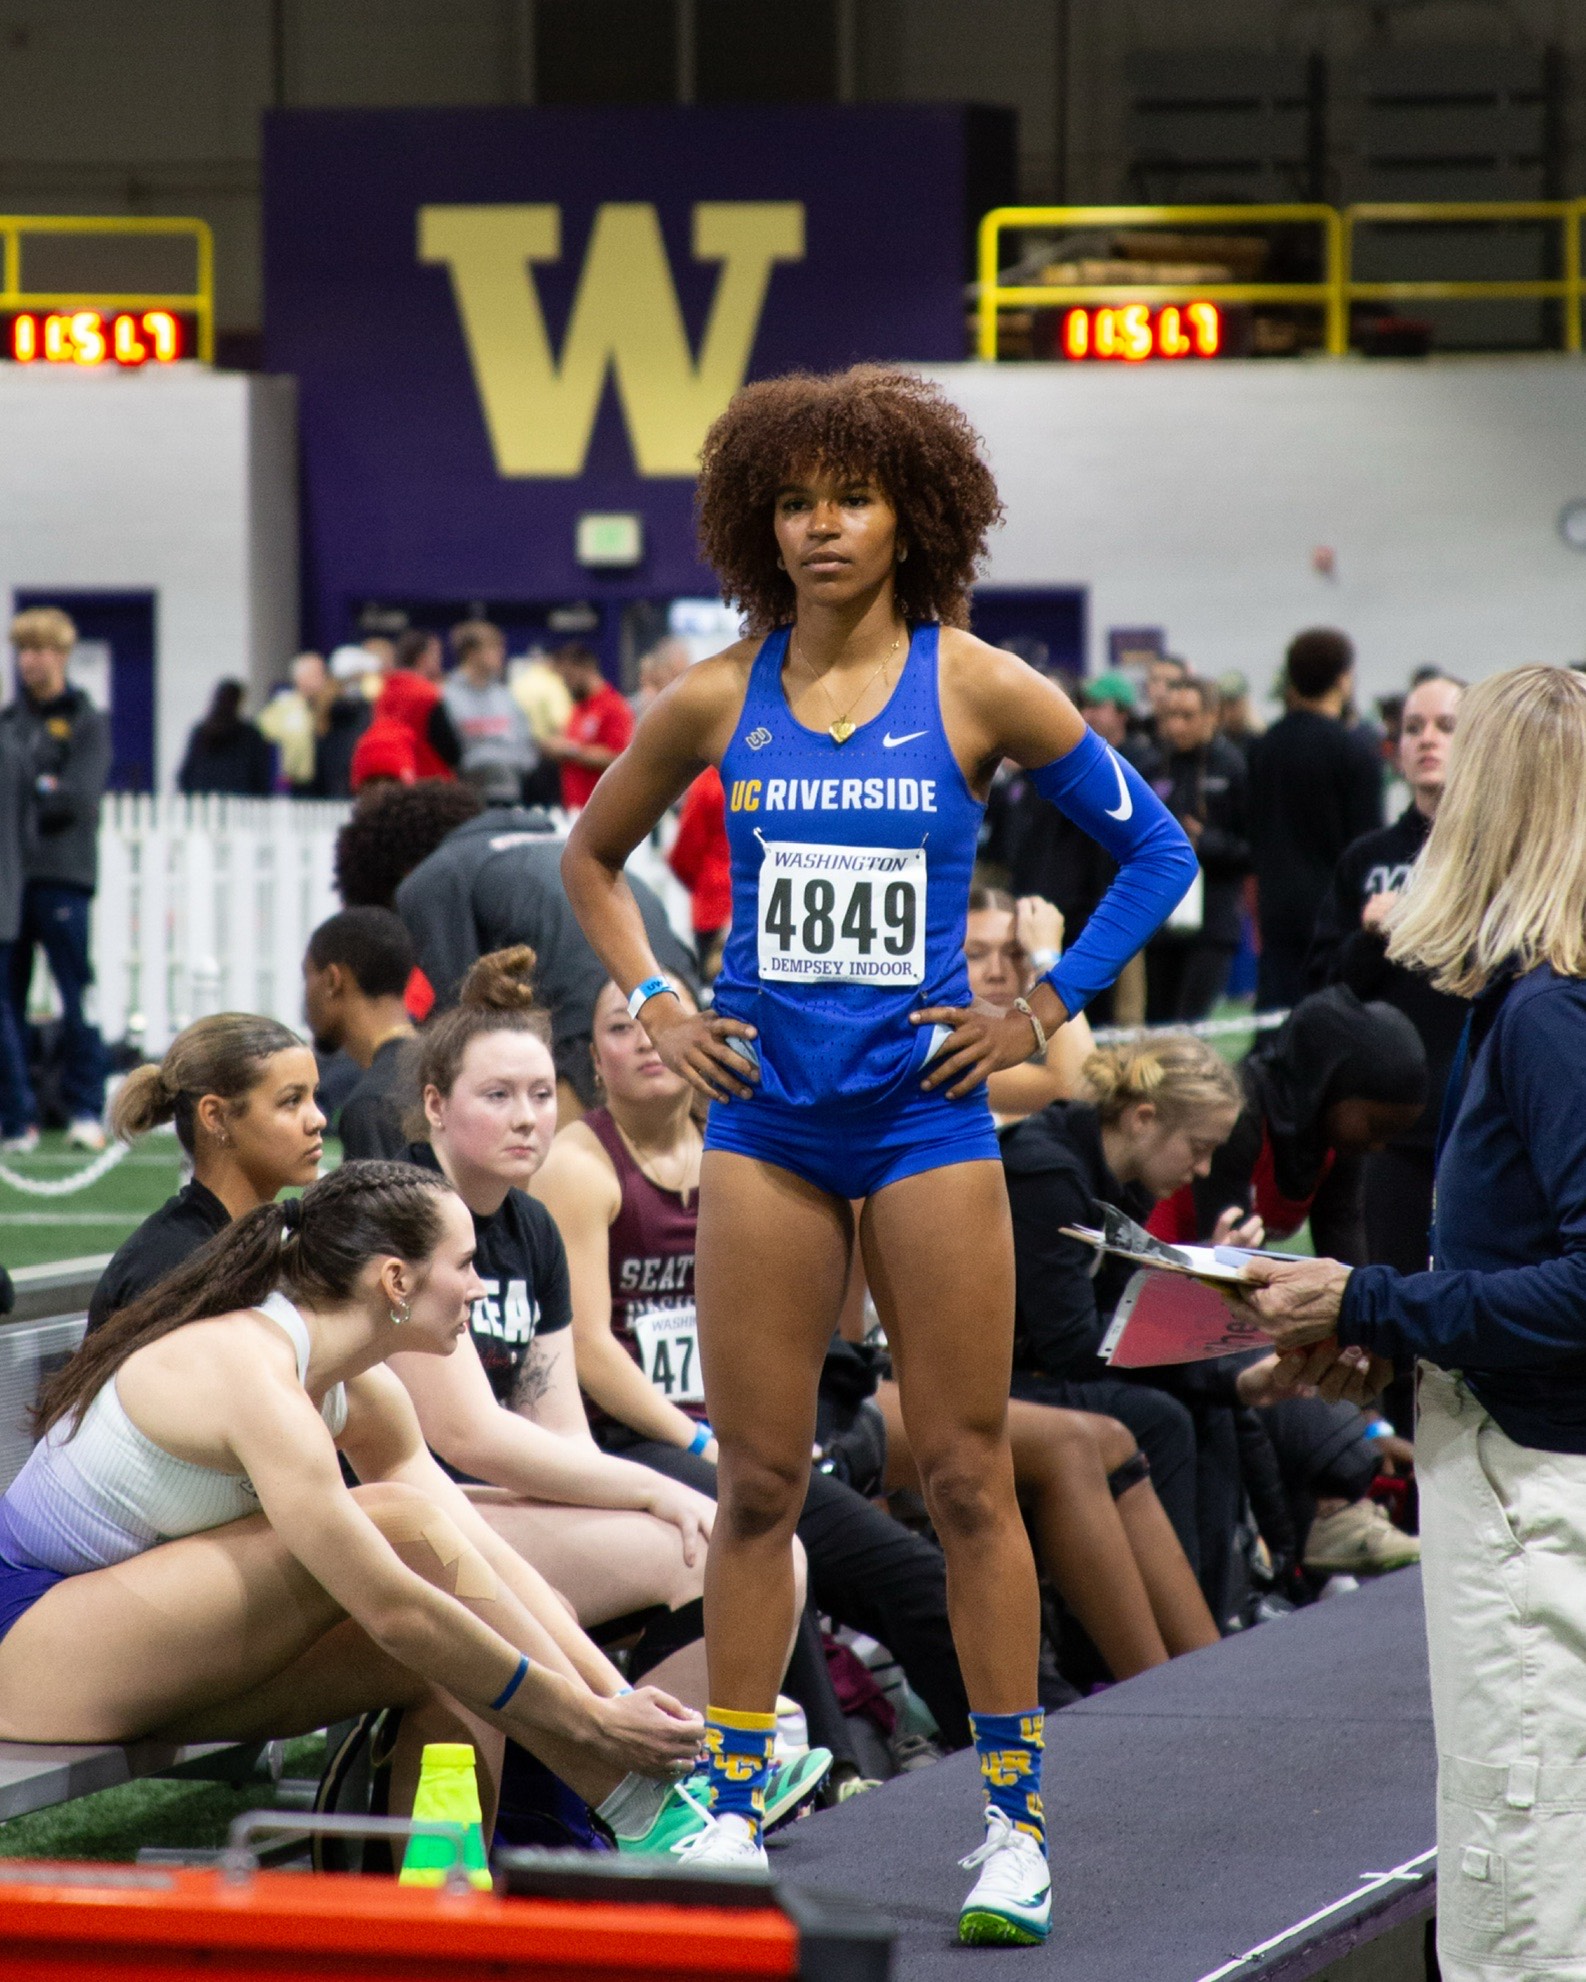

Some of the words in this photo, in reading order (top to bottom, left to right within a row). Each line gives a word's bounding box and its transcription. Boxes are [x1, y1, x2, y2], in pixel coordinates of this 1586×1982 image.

[415, 203, 806, 478] W
[730, 779, 762, 812] UC
[766, 778, 937, 812] RIVERSIDE
[774, 851, 908, 872] WASHINGTON
[765, 878, 916, 956] 4849
[771, 957, 843, 975] DEMPSEY
[850, 961, 912, 976] INDOOR
